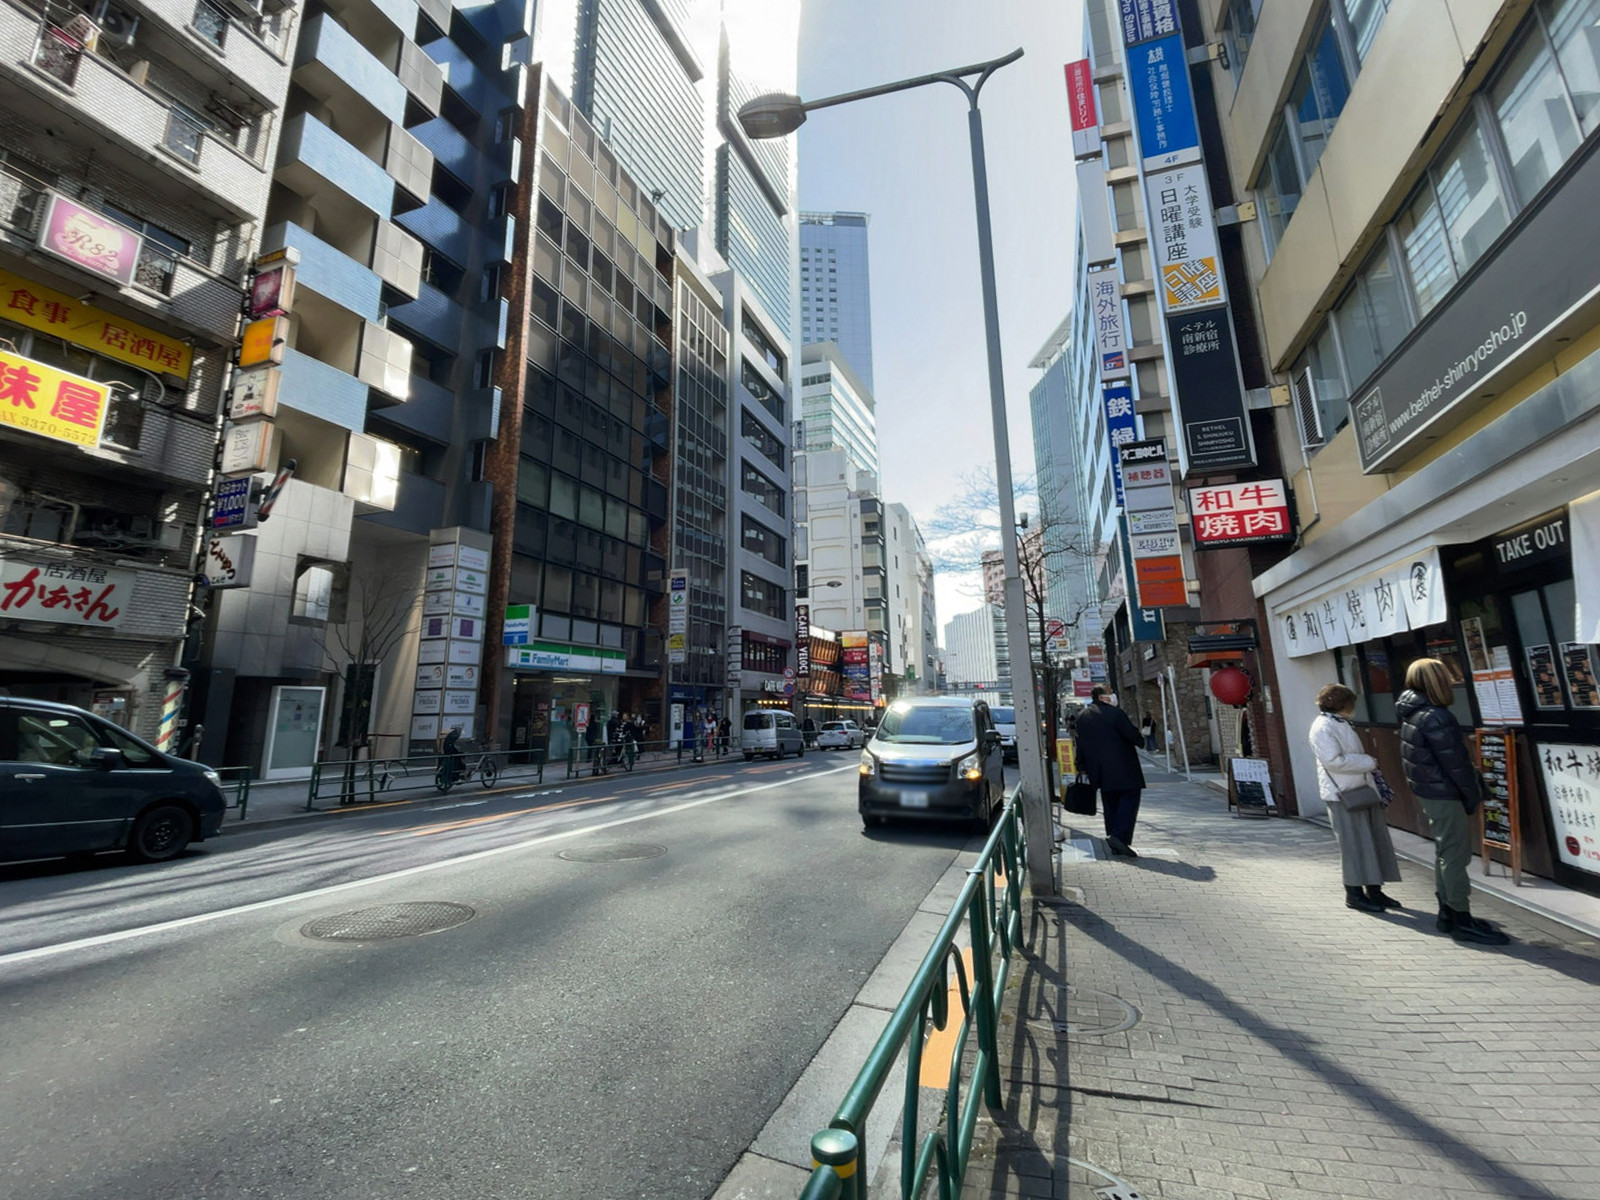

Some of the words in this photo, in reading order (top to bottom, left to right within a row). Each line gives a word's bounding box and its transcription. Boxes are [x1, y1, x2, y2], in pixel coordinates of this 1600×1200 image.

[1124, 14, 1136, 43] Status
[1164, 155, 1179, 164] 4F
[1184, 184, 1204, 229] 大学受験
[1160, 188, 1189, 262] 日曜講座
[1095, 280, 1120, 348] 海外旅行
[1180, 319, 1217, 332] ベテル
[1181, 328, 1219, 345] 南新宿
[1183, 340, 1221, 355] 診療所
[1388, 310, 1528, 434] www.bethel-shinryosho.jp
[20, 416, 97, 446] 3370-5572
[1196, 485, 1279, 511] 和牛
[1199, 511, 1284, 538] 焼肉
[1496, 532, 1533, 564] TAKE
[1534, 520, 1564, 551] OUT
[44, 562, 108, 584] 居酒屋
[1303, 577, 1395, 638] 和牛焼肉
[798, 615, 808, 643] CAFFE
[532, 653, 569, 667] FamilyMart
[798, 645, 809, 675] VELOCE
